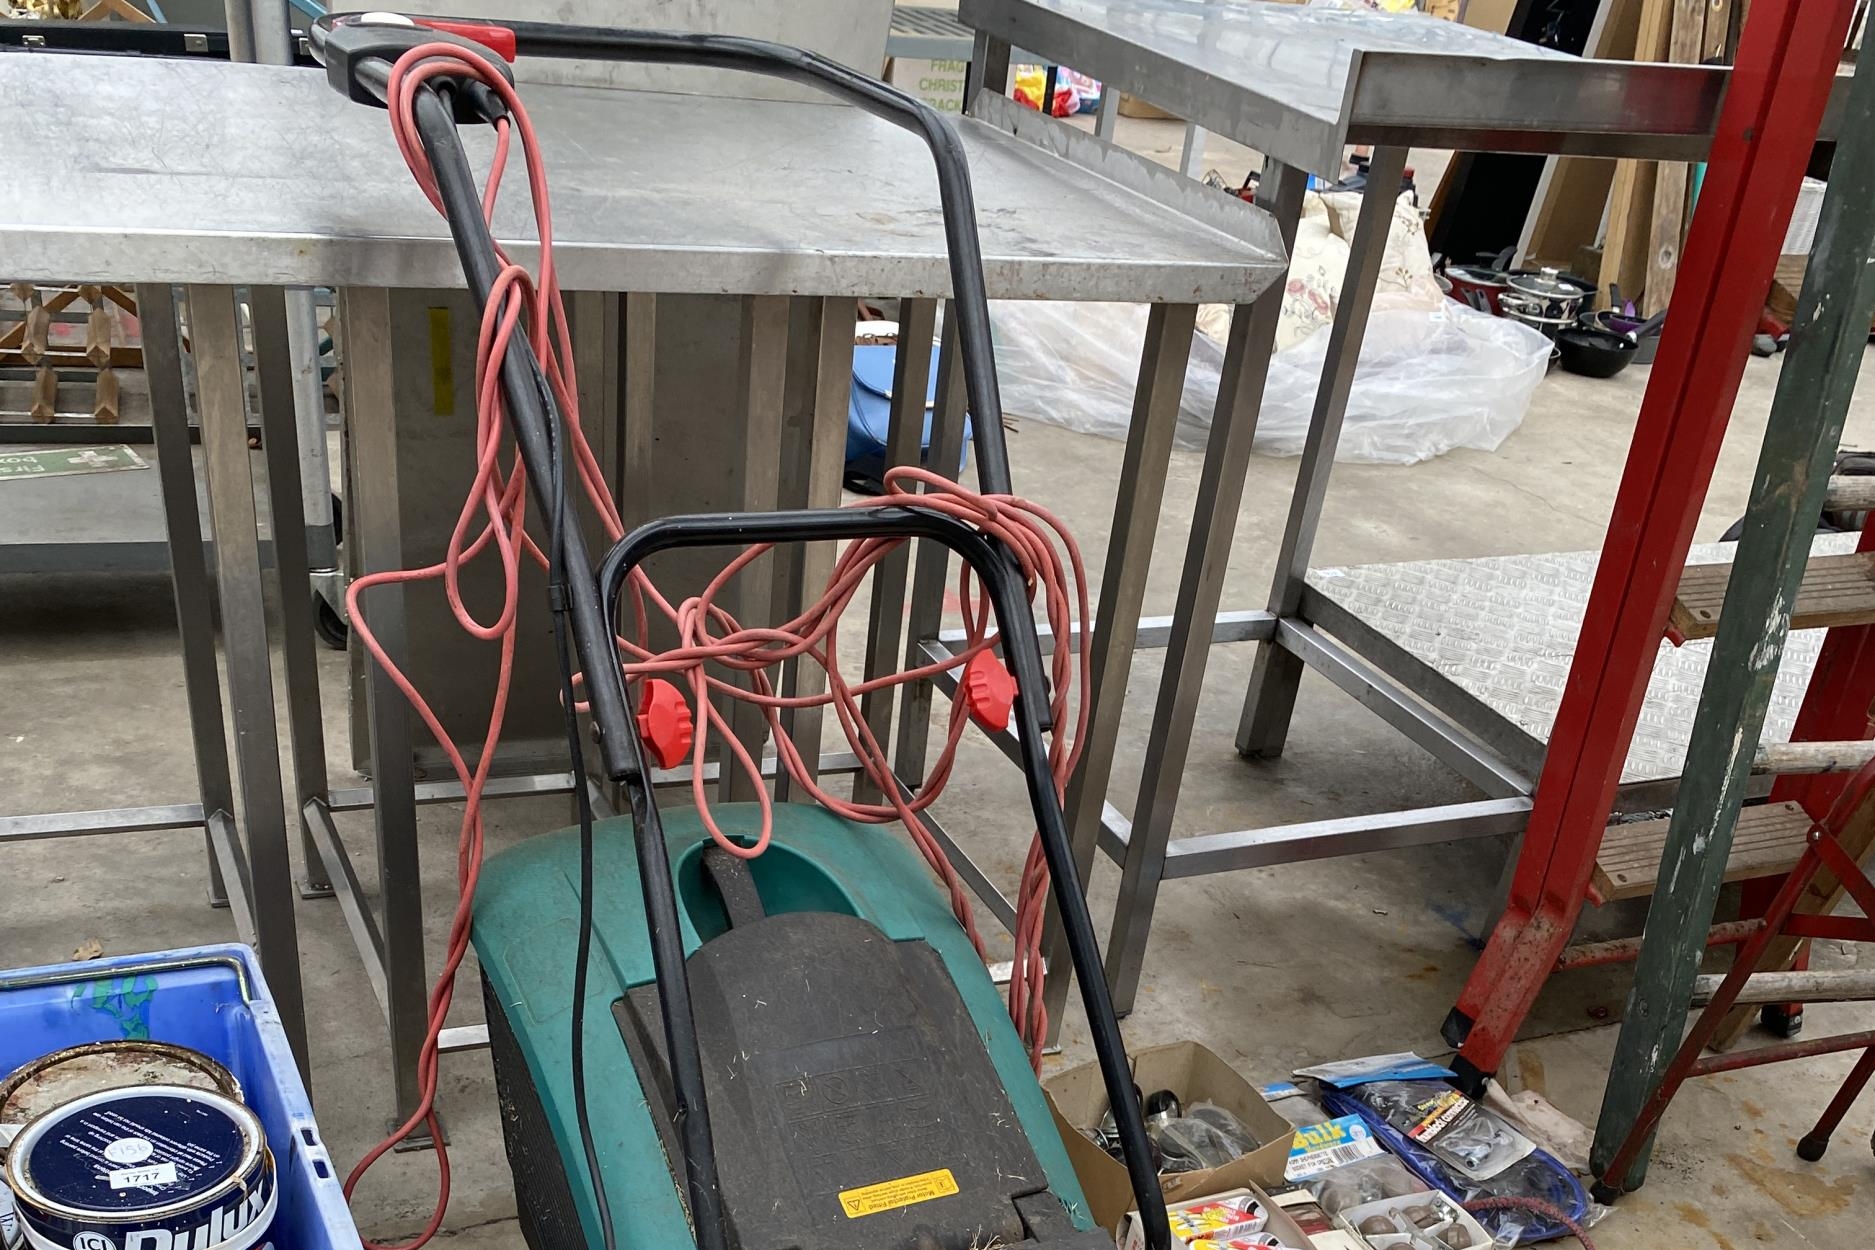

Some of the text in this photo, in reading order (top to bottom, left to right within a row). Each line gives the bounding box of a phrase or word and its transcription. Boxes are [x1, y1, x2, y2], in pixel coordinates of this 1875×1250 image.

[930, 60, 965, 73] FRAG
[919, 78, 963, 92] CHRIST
[0, 464, 45, 473] Firs
[124, 1172, 160, 1183] 1717
